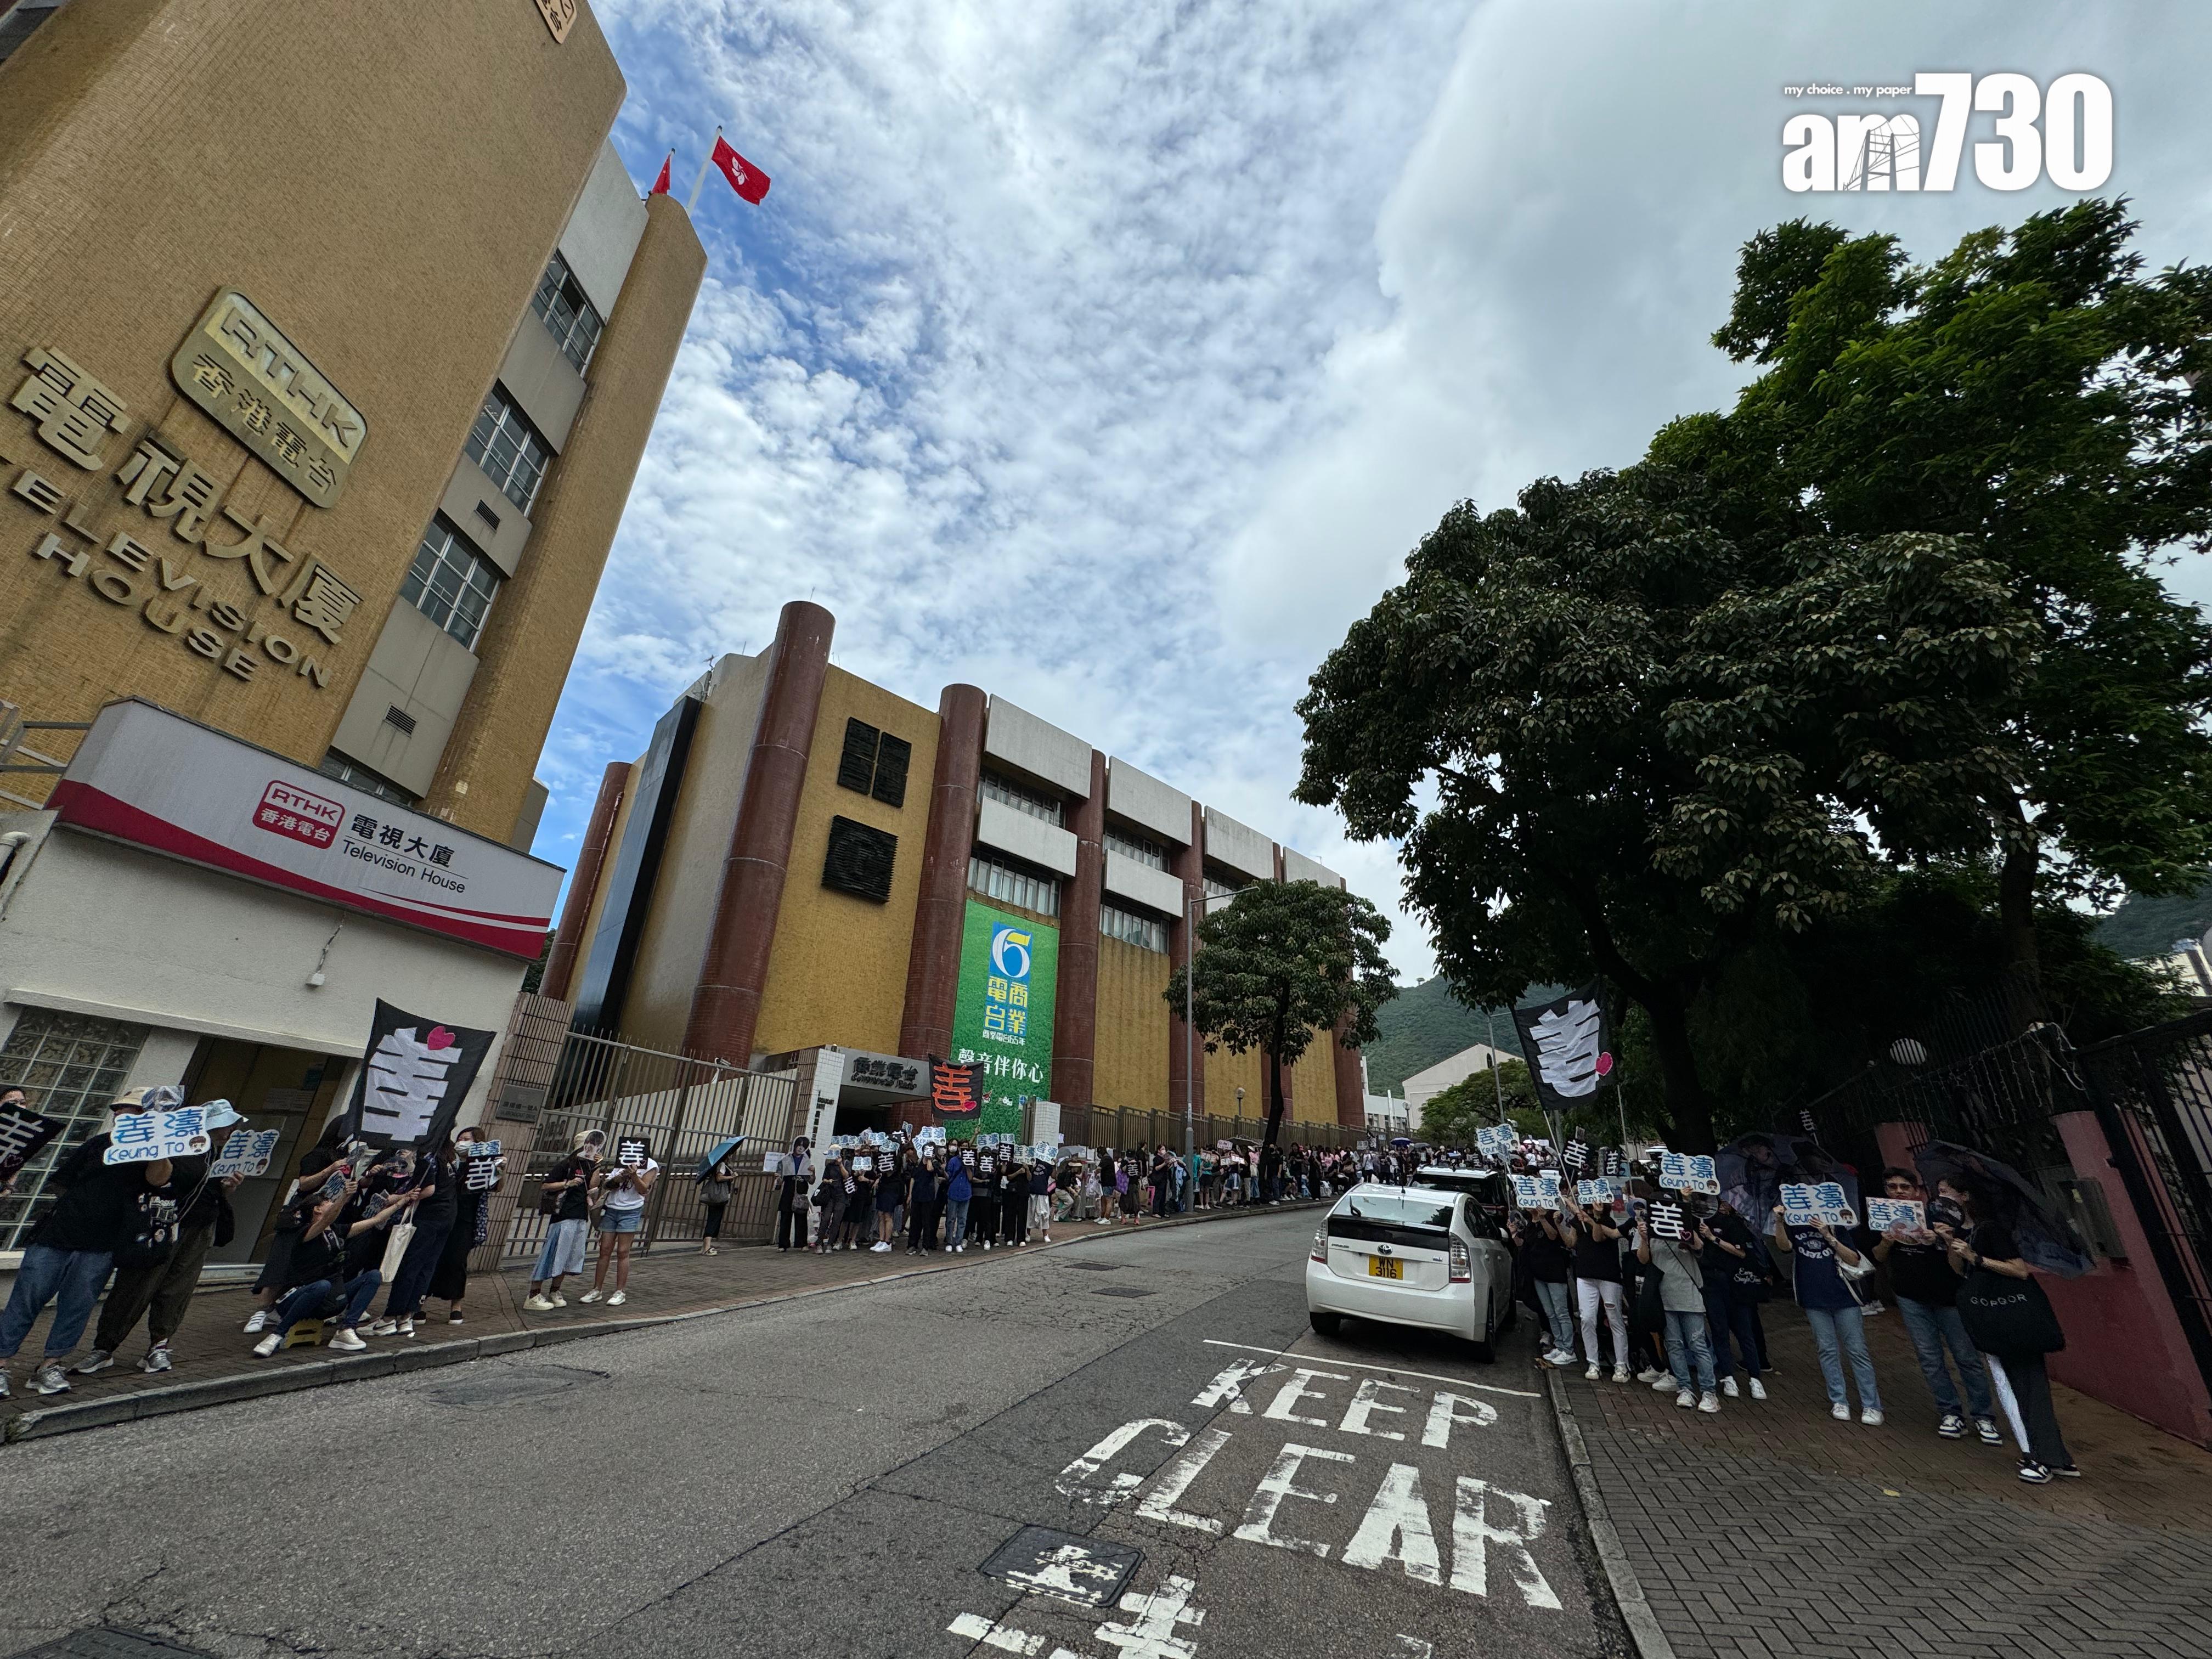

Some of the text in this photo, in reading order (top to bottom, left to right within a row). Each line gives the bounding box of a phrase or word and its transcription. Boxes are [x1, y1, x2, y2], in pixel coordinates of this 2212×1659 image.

[221, 307, 357, 449] RTHK
[192, 353, 337, 495] 香港電台
[0, 454, 330, 688] ELEVISION
[34, 532, 260, 682] HOUSE
[272, 788, 339, 821] RTHK
[261, 808, 330, 842] 香港電台
[351, 814, 455, 868] 電視大廈
[342, 839, 465, 893] Television House
[618, 1139, 645, 1166] 姜
[878, 1153, 895, 1172] 姜
[962, 1149, 975, 1166] 姜
[979, 1155, 994, 1172] 姜
[999, 1145, 1012, 1162] 姜
[1563, 1139, 1589, 1169] 姜
[1606, 1150, 1618, 1174] 姜
[1650, 1201, 1684, 1240] 姜
[1375, 1267, 1397, 1279] 3116
[1379, 1257, 1393, 1268] WN
[1190, 1358, 1498, 1449] KEEP
[1055, 1418, 1564, 1610] CLEAR
